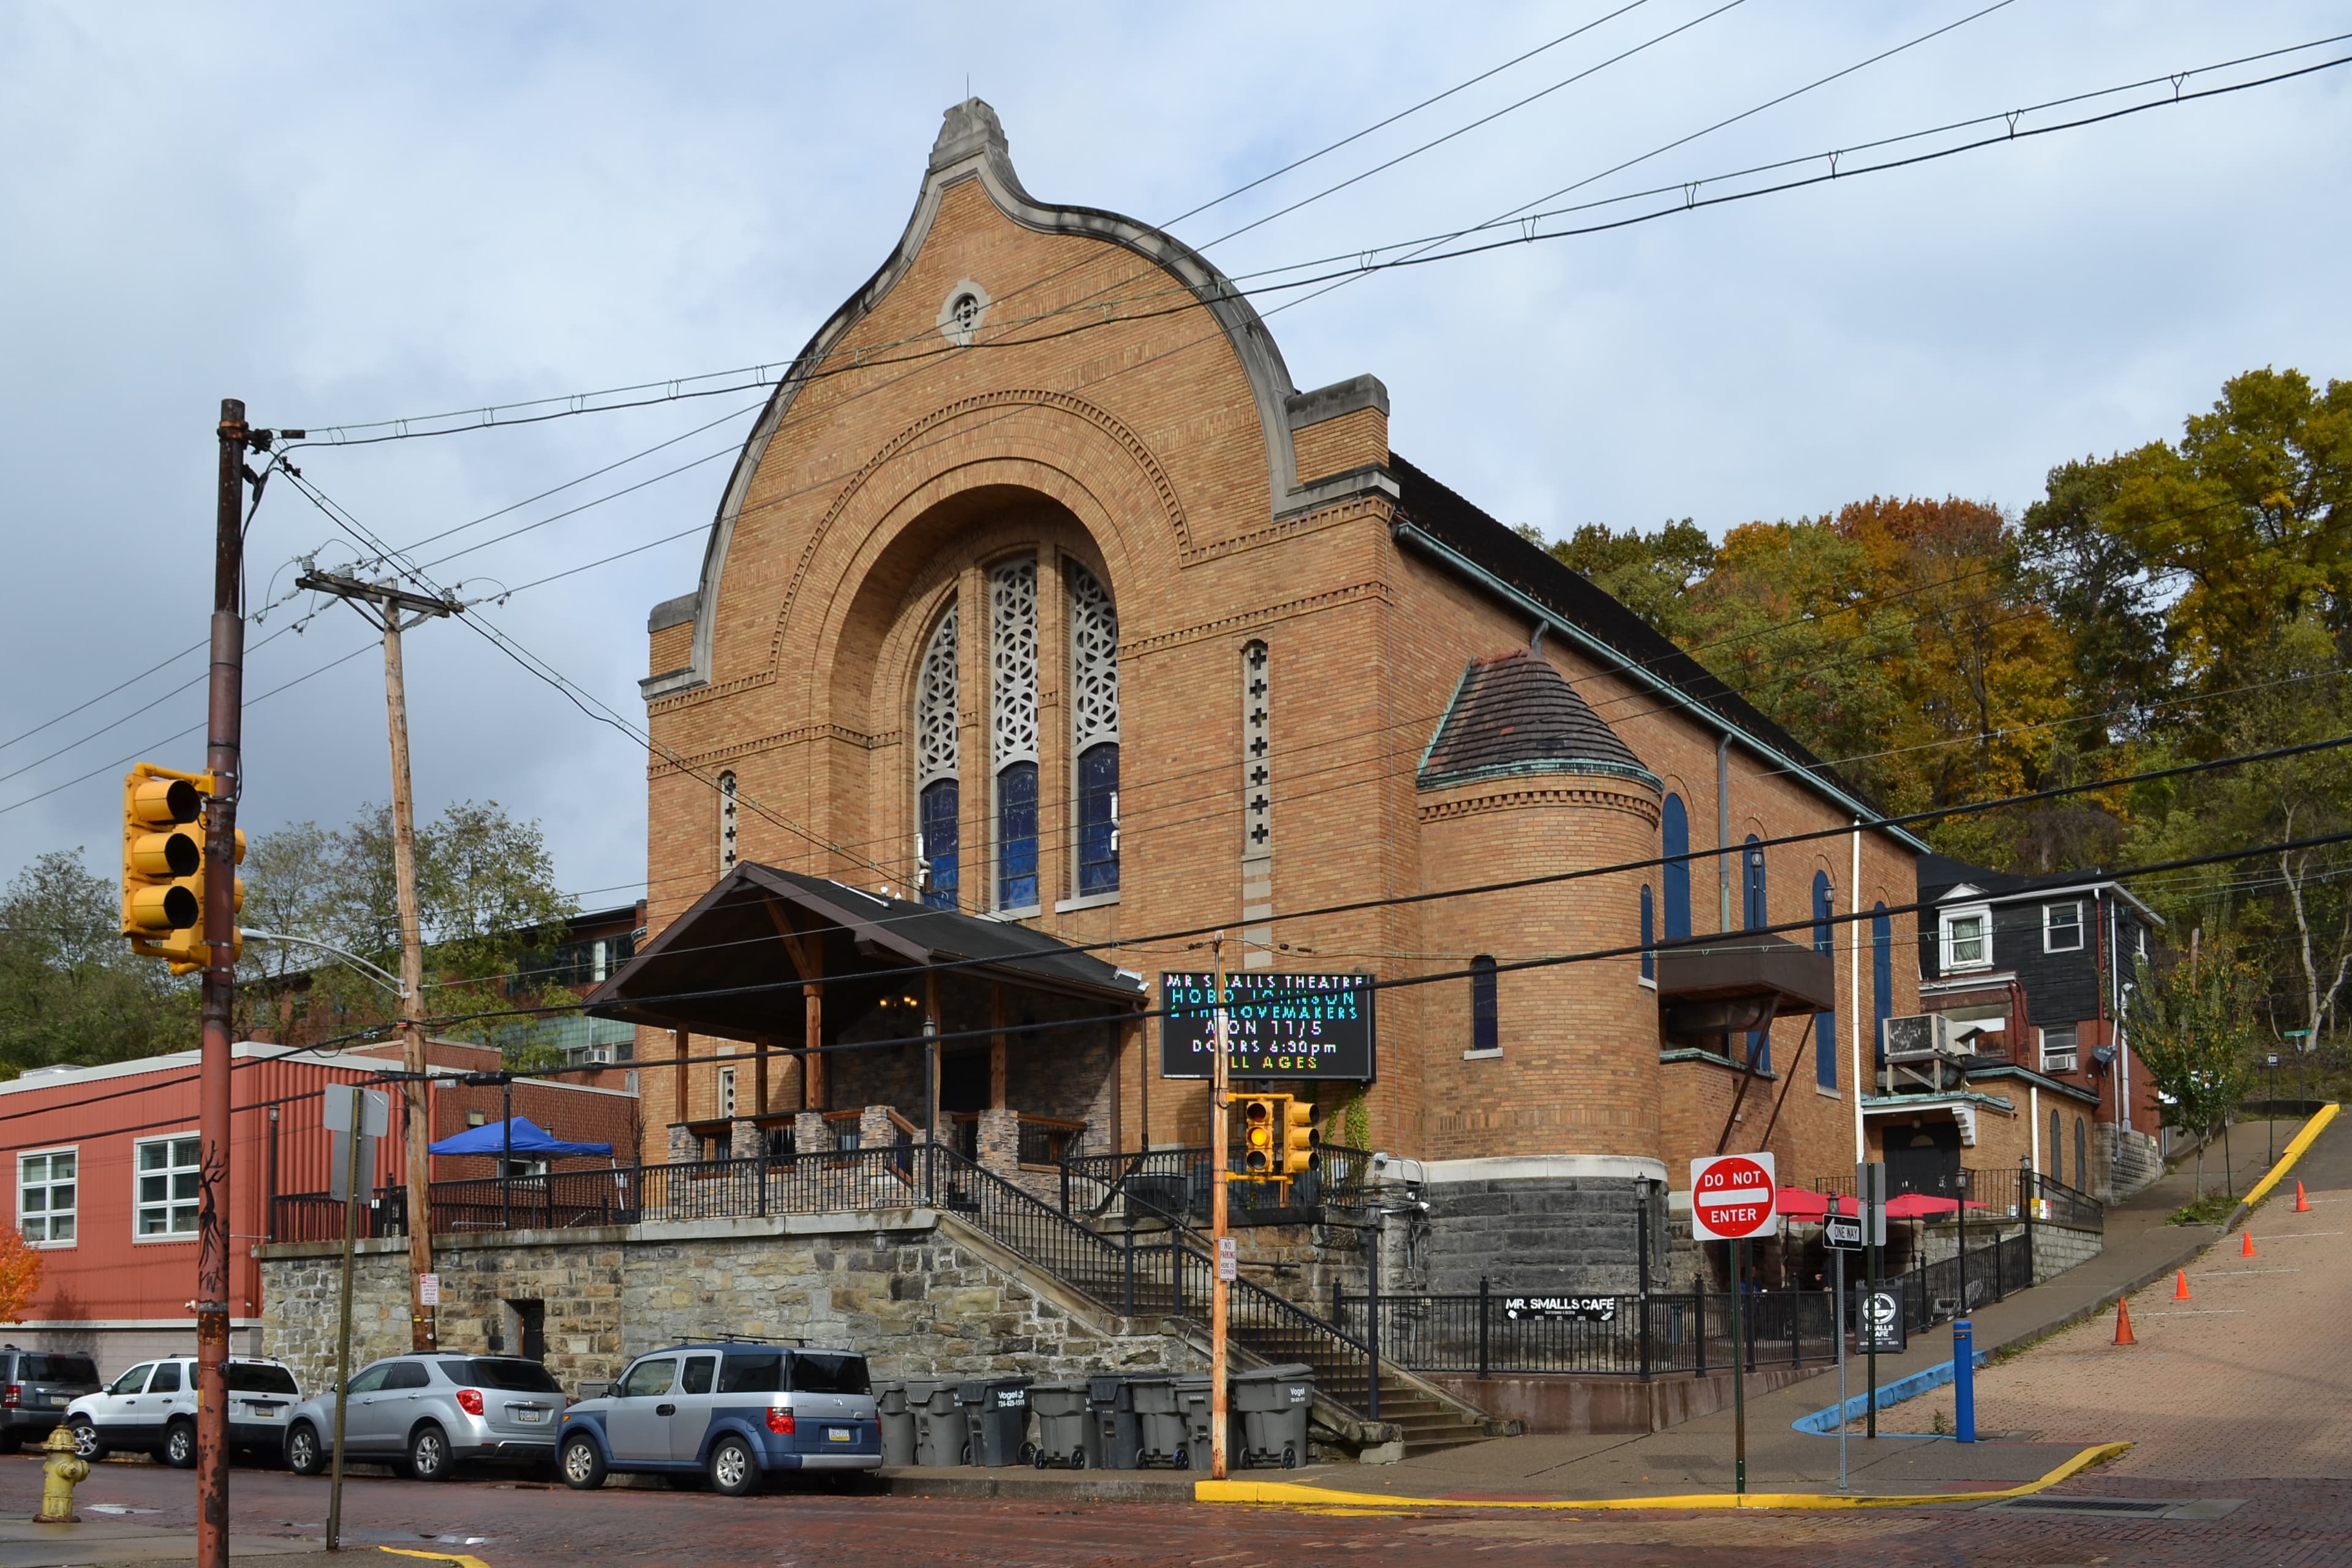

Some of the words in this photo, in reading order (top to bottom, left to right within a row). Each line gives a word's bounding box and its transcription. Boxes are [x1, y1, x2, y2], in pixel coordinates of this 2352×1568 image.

[1167, 974, 1191, 987] MR
[1203, 974, 1275, 988] SALLS
[1285, 976, 1362, 989] THEATRE
[1231, 1006, 1357, 1020] LOVEMAKERS
[1271, 1020, 1321, 1038] 11/5
[1231, 1056, 1249, 1068] LL
[1263, 1056, 1317, 1069] AGES
[1705, 1174, 1724, 1187] DO
[1733, 1170, 1761, 1185] NOT
[1711, 1208, 1757, 1223] ENTER
[1834, 1226, 1845, 1238] ONE
[1847, 1227, 1858, 1240] WAY
[1506, 1298, 1527, 1310] MR.
[1530, 1298, 1580, 1310] SMALLS
[1581, 1297, 1615, 1310] CAFÉ
[998, 1390, 1017, 1400] Vogel
[1290, 1387, 1305, 1396] Vogel
